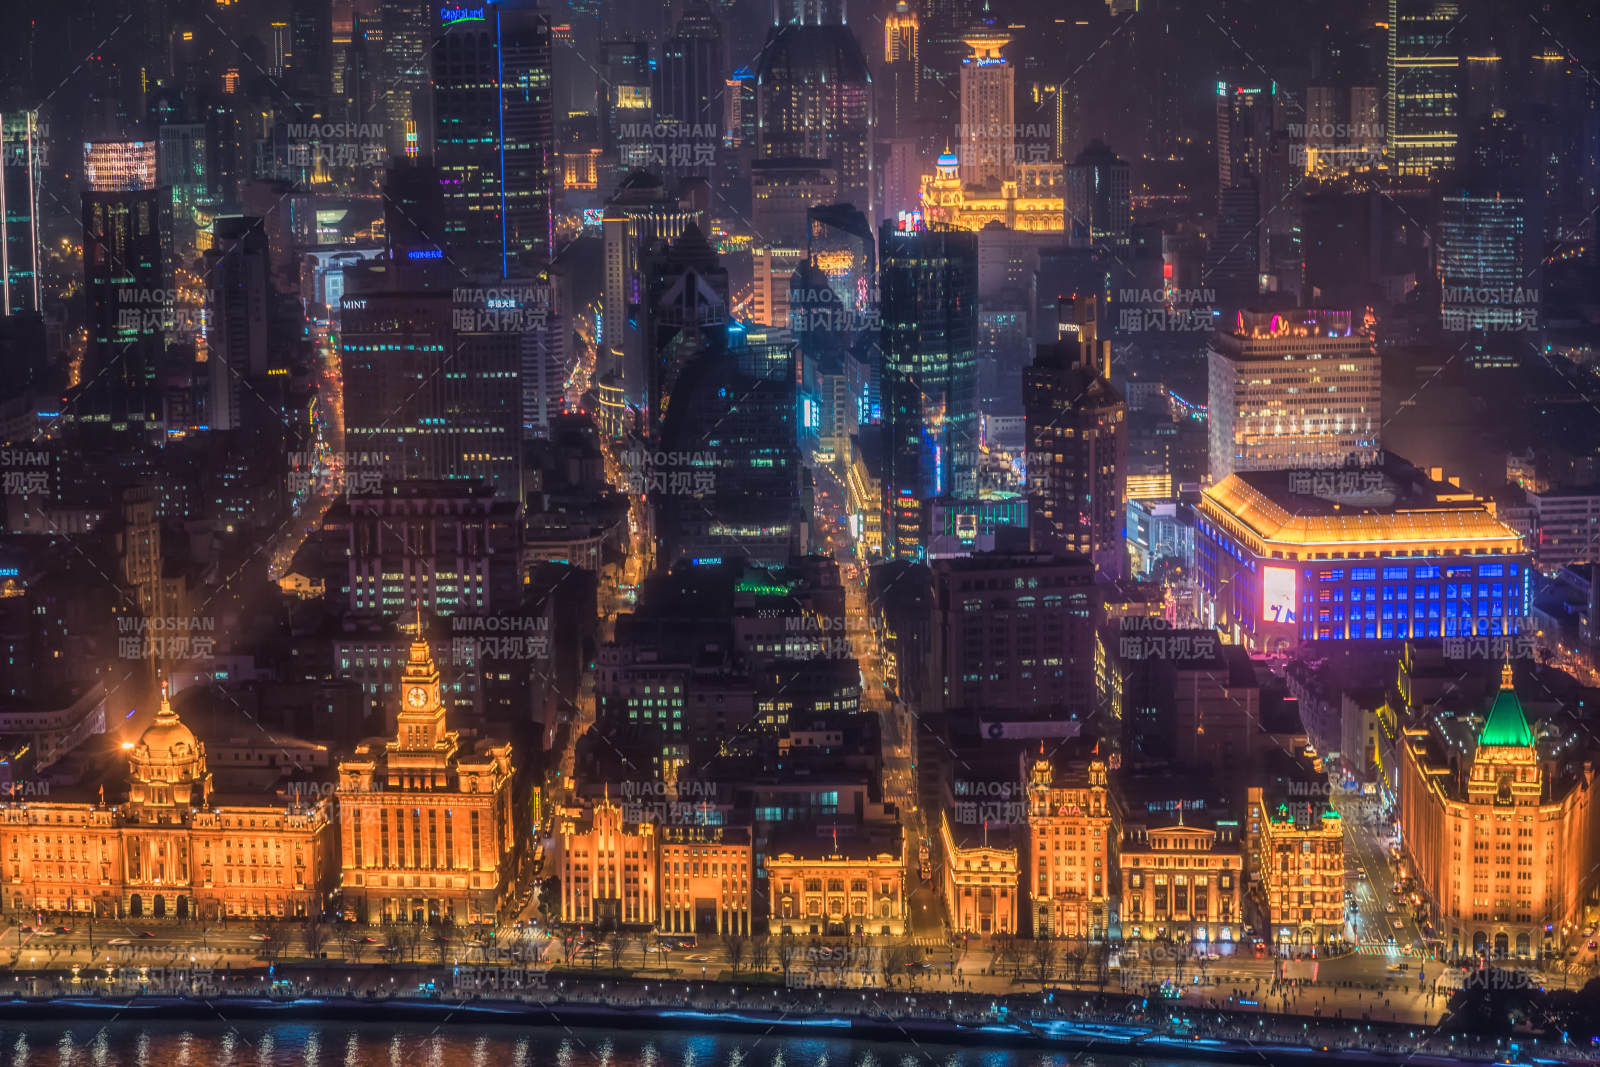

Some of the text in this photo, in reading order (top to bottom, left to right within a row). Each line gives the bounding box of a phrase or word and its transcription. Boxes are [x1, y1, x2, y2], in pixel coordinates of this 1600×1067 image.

[440, 7, 484, 21] CapitaLand
[343, 300, 367, 310] MINT
[1058, 806, 1082, 816] AIA
